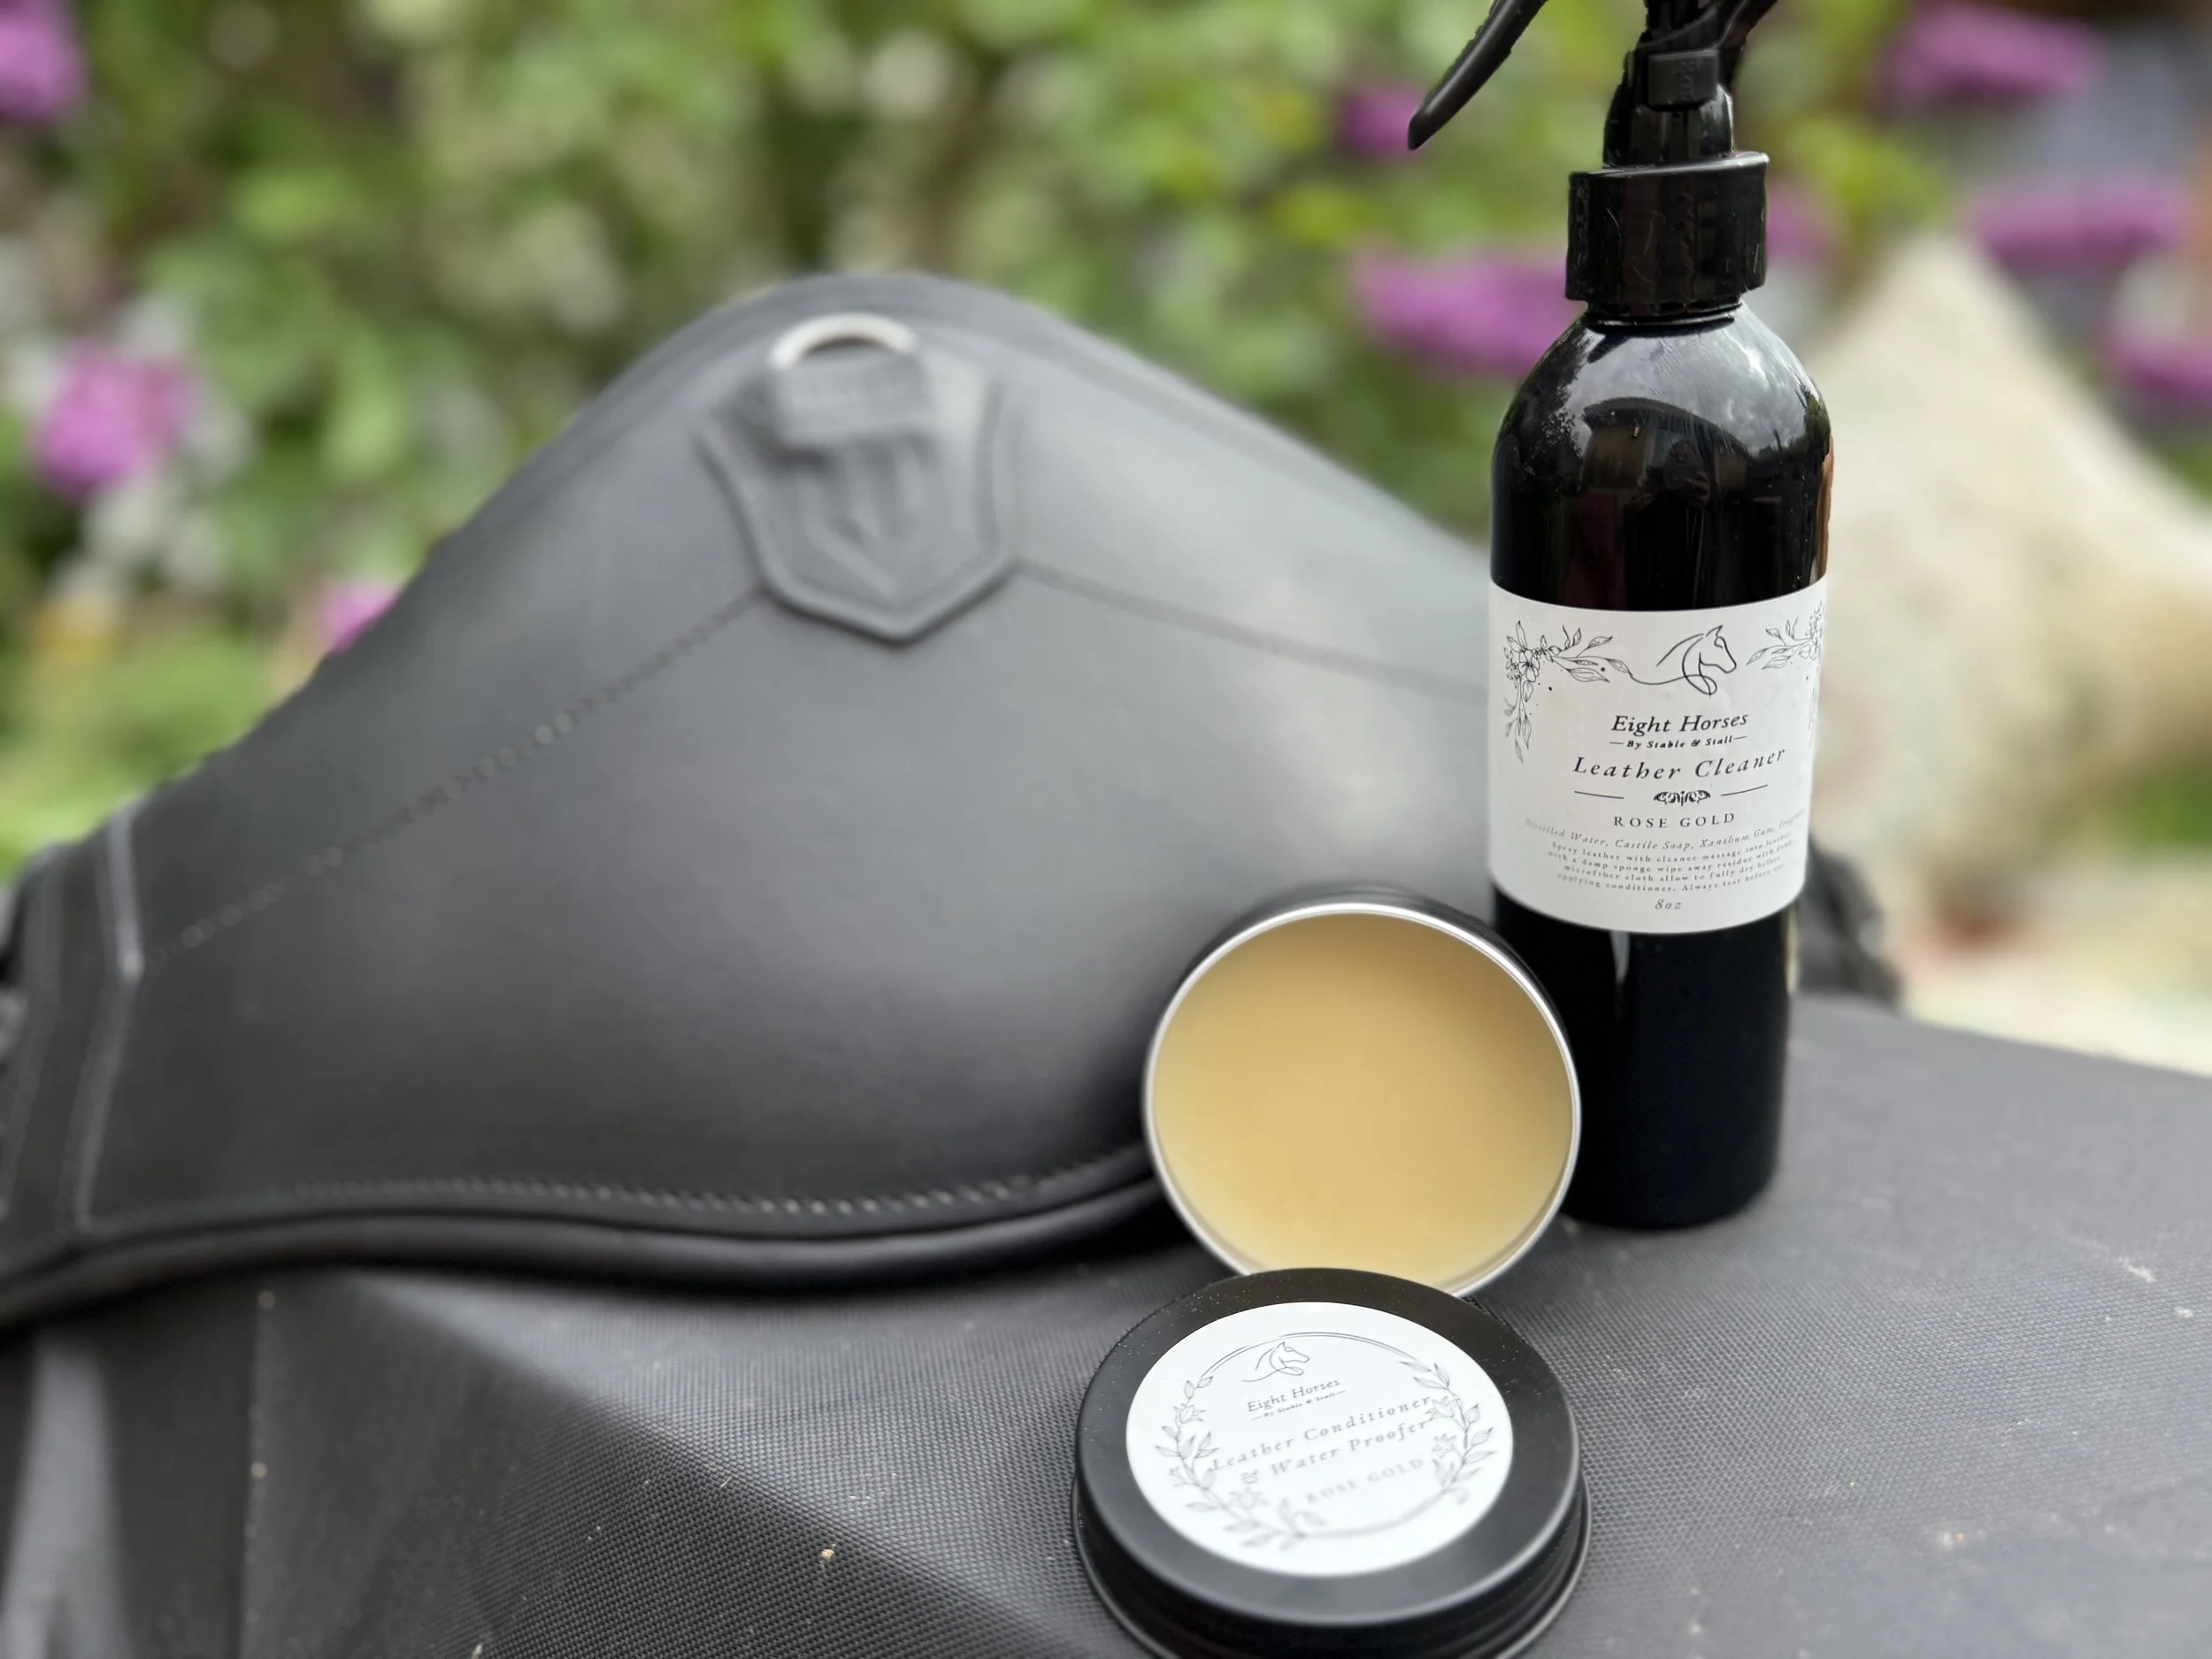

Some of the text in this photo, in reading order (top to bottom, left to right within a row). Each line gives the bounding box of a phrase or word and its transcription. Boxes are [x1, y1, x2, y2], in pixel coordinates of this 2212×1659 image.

[1610, 713, 1749, 737] Eight Horses
[1626, 740, 1642, 749] By
[1647, 740, 1686, 749] Stable
[1705, 735, 1733, 747] Stall
[1572, 748, 1786, 780] Leather Cleaner
[1613, 811, 1736, 829] ROSE GOLD
[1552, 841, 1578, 856] Spray
[1582, 849, 1621, 862] leather
[1626, 854, 1651, 863] with
[1656, 853, 1698, 863] cleaner
[1701, 849, 1741, 861] massage
[1615, 839, 1659, 850] Castile
[1662, 841, 1694, 852] Soap,
[1581, 858, 1609, 870] damp
[1613, 864, 1652, 874] sponge
[1656, 865, 1683, 874] wipe
[1687, 864, 1713, 873] away
[1624, 873, 1655, 882] cloth
[1659, 874, 1690, 883] allow
[1694, 872, 1705, 881] to
[1709, 868, 1735, 880] fully
[1681, 882, 1719, 893] Always
[1723, 878, 1742, 887] test
[1654, 898, 1682, 910] 8oz
[1247, 1379, 1340, 1413] Eight Horses
[1207, 1395, 1432, 1473] Leather Conditioner
[1271, 1447, 1340, 1476] Water
[1348, 1419, 1429, 1453] Proofer
[1366, 1457, 1425, 1484] GOLD
